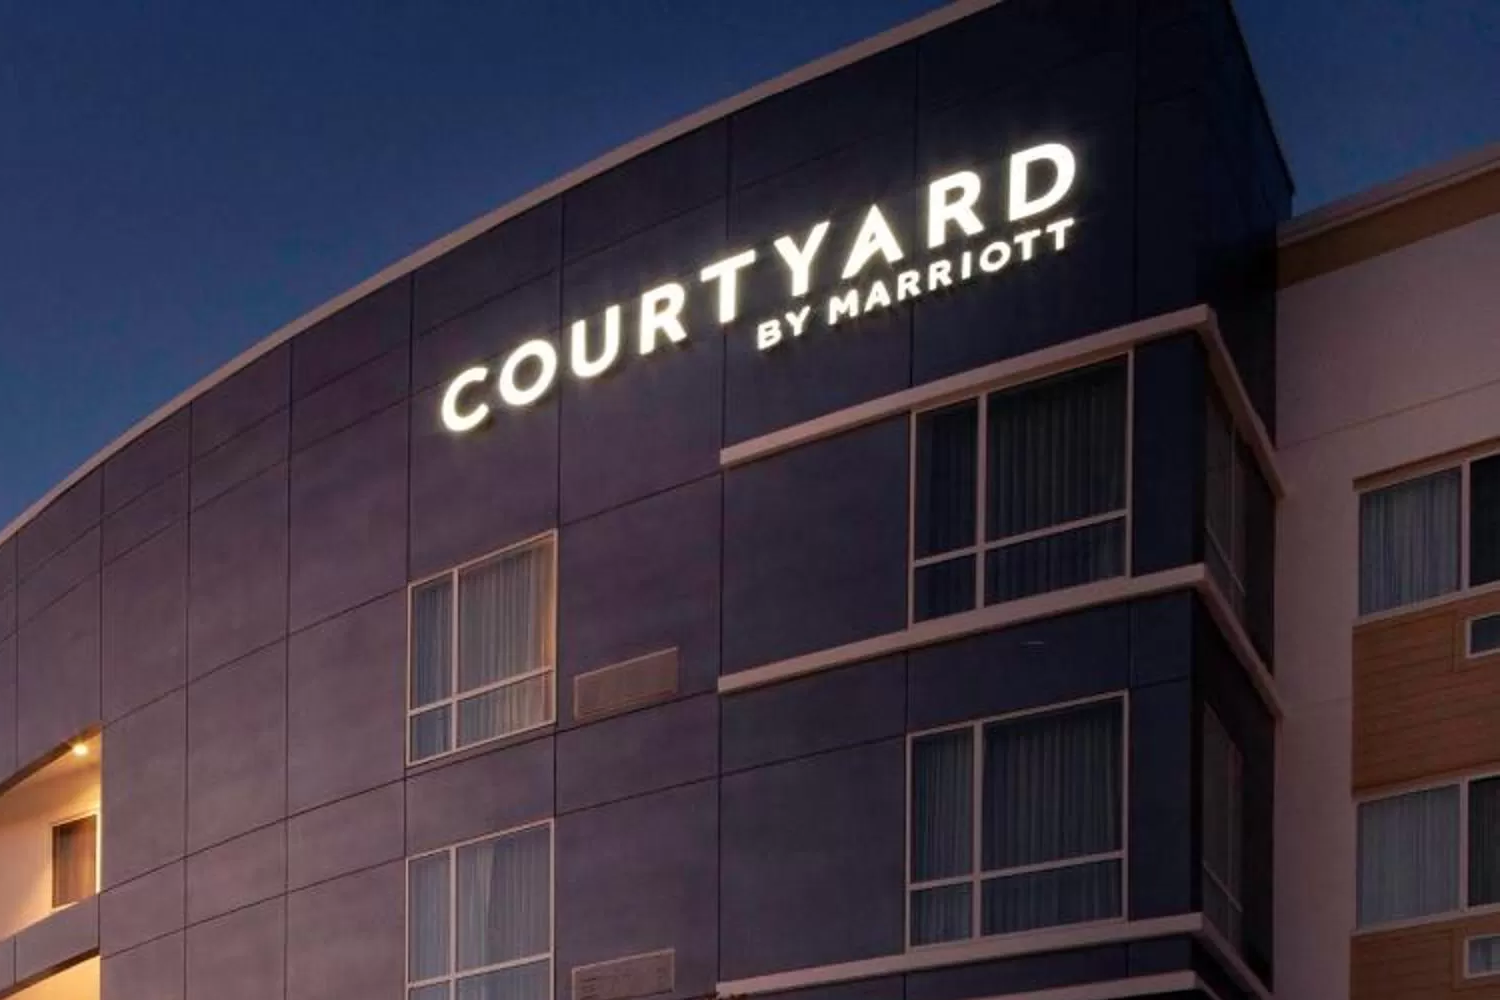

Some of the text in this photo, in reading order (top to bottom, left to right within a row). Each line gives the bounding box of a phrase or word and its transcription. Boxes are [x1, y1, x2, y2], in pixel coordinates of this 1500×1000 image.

[441, 143, 1076, 432] COURTYARD
[756, 217, 1074, 351] BY MARRIOTT
